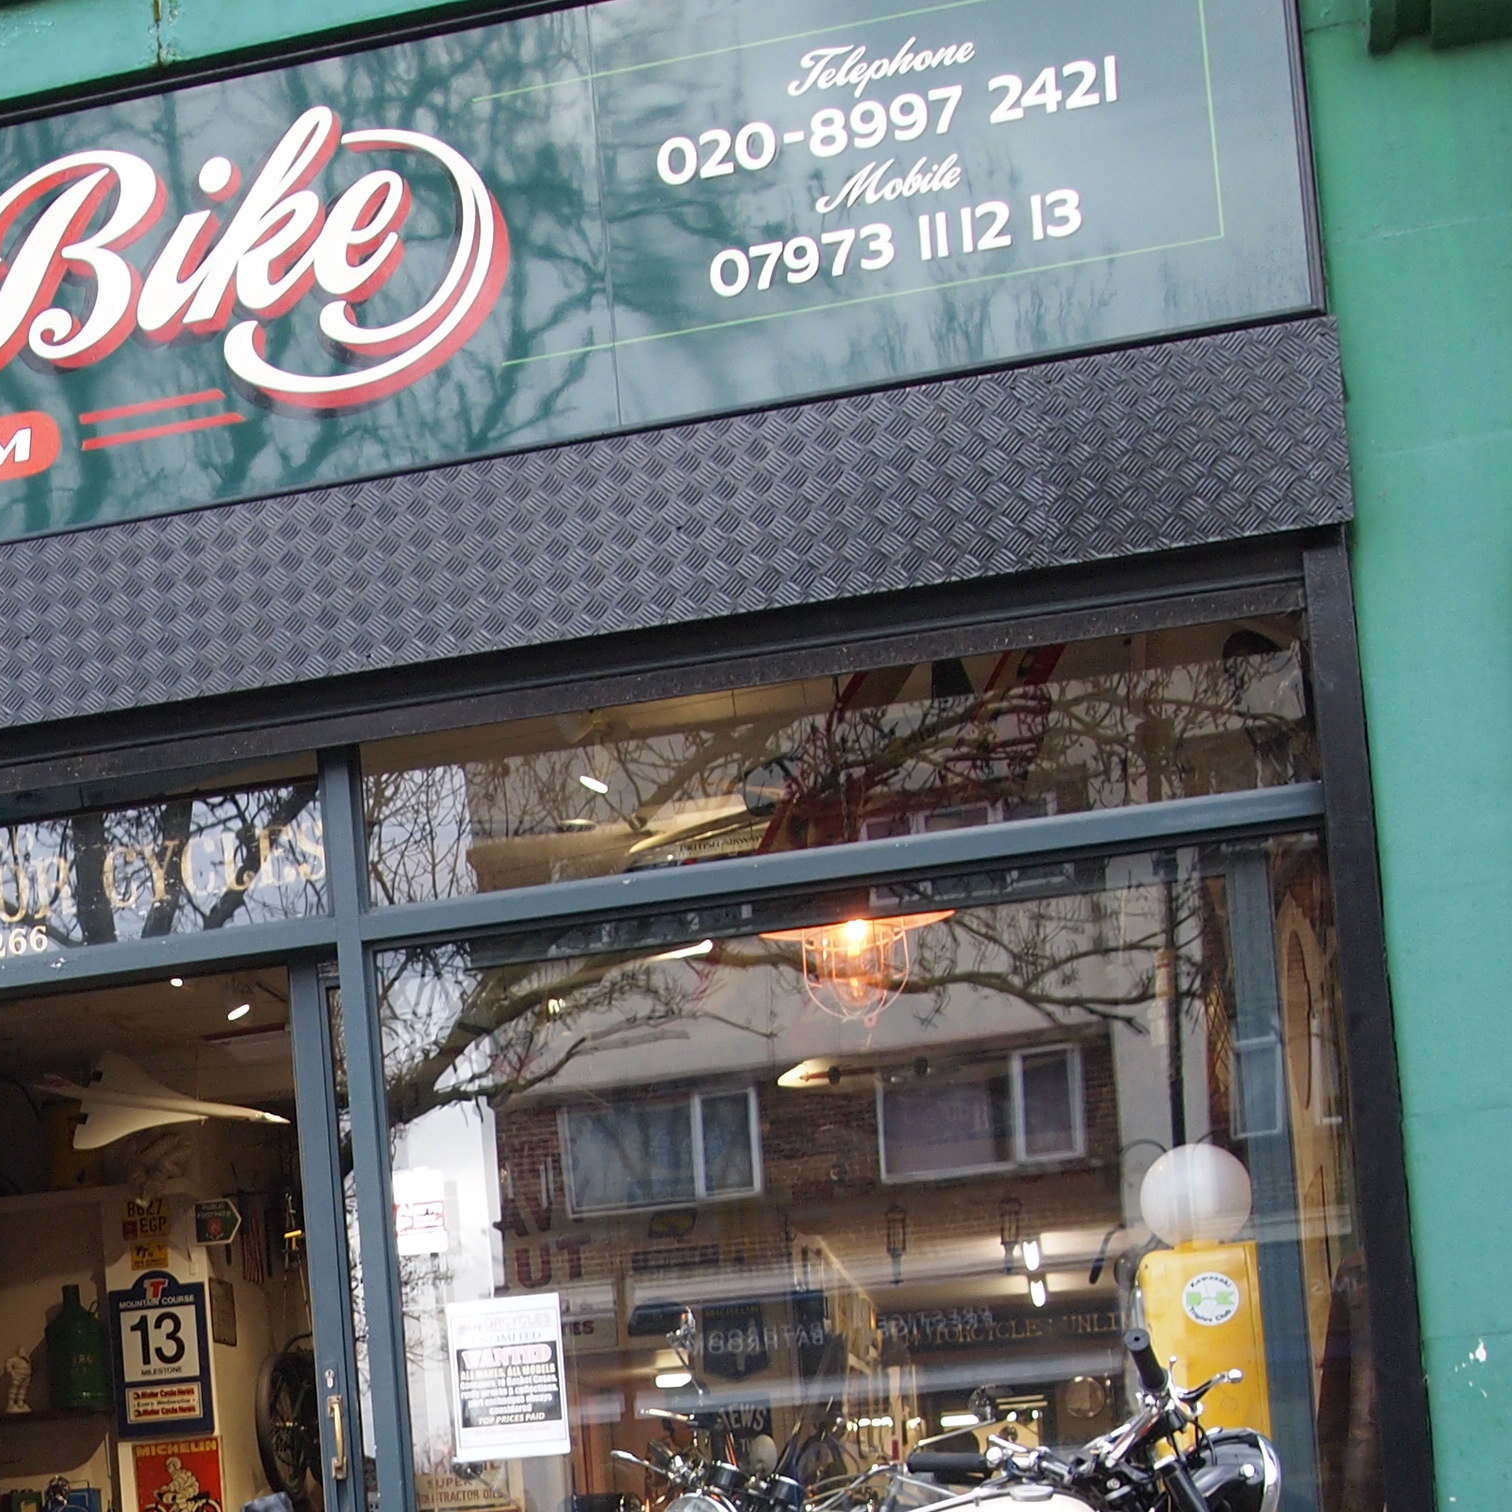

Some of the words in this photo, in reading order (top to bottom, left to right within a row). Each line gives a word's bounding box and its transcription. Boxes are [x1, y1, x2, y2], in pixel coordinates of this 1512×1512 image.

[788, 37, 975, 97] Telephone
[656, 85, 963, 186] 020-8997
[988, 55, 1118, 124] 2421
[815, 153, 961, 215] Mobile
[708, 222, 894, 297] 07973
[103, 820, 326, 908] CYCLES
[1191, 1276, 1232, 1288] Kawasaki
[119, 1299, 159, 1309] MOUNTAIN
[161, 1294, 195, 1305] COURSE
[130, 1312, 185, 1366] 13
[141, 1366, 182, 1376] MILESTONE
[507, 1365, 521, 1376] ALL
[522, 1363, 555, 1374] MODELS
[478, 1416, 495, 1425] TOP
[496, 1414, 524, 1424] PRICES
[526, 1411, 545, 1421] PAID
[135, 1441, 217, 1457] MICHELIN
[439, 1489, 479, 1503] TRACTOR
